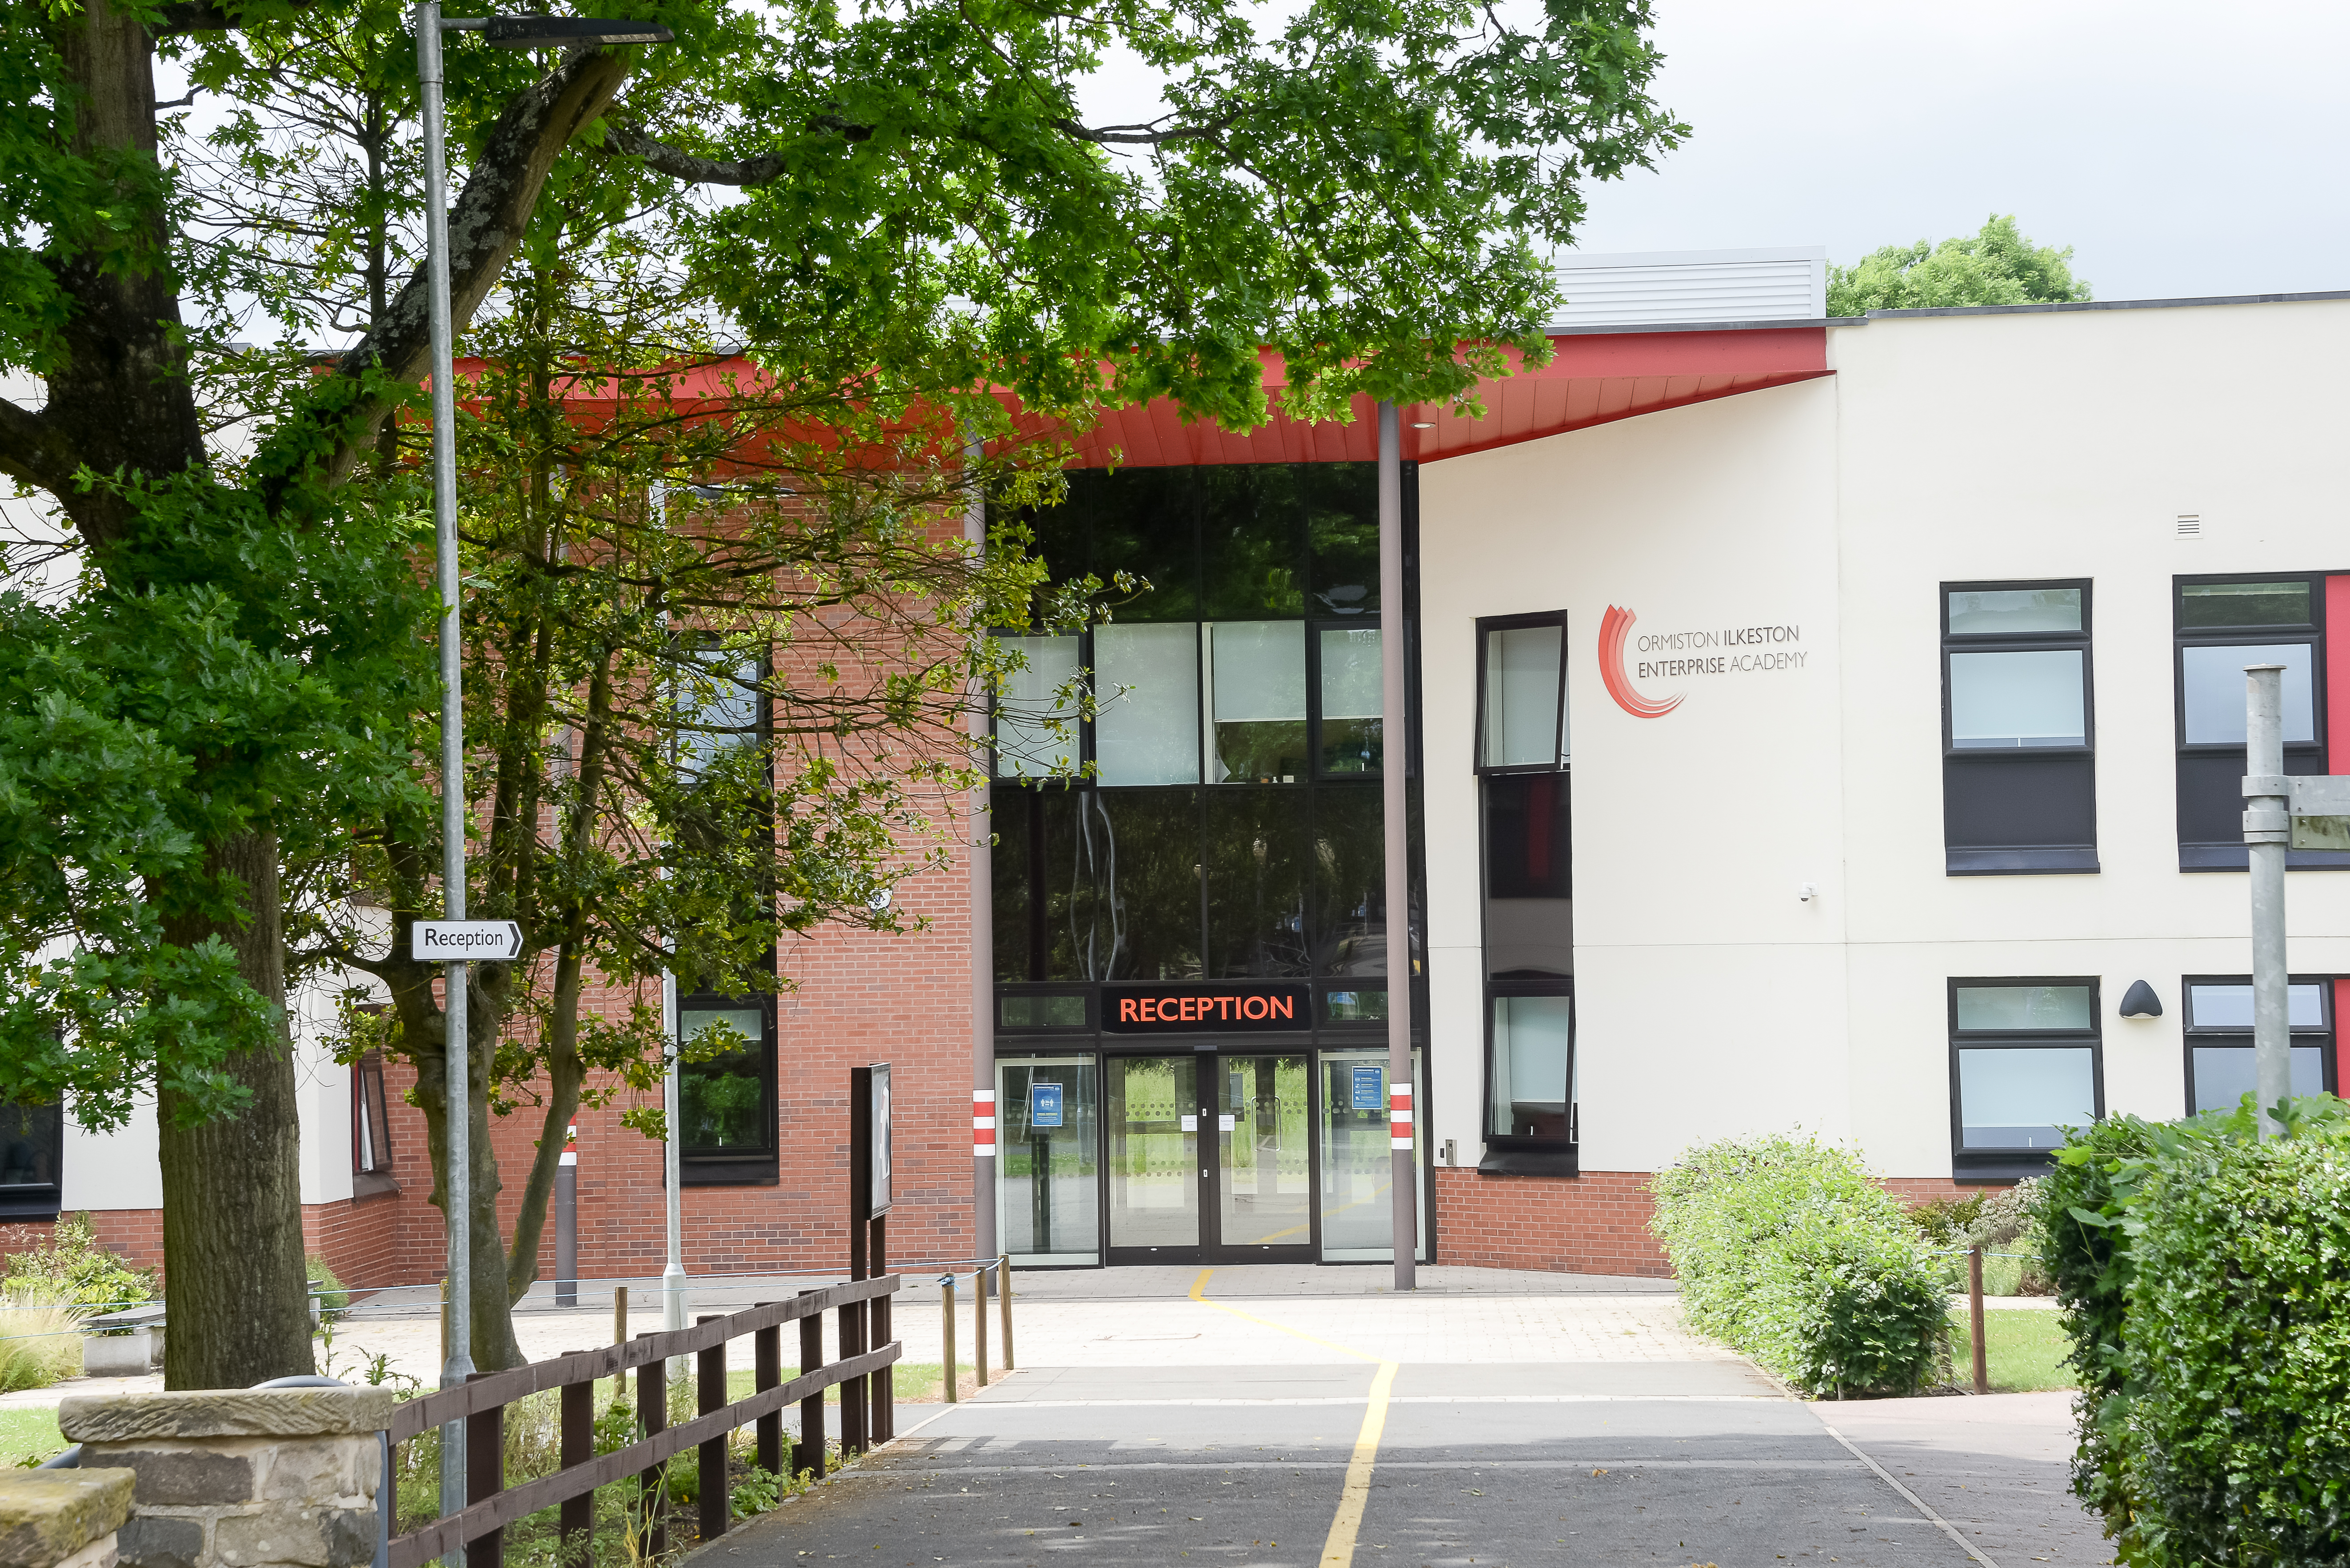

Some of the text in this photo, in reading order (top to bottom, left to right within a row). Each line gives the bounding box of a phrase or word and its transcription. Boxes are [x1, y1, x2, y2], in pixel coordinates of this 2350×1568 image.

[1637, 625, 1799, 652] ORMISTON ILKESTON
[1639, 651, 1808, 678] ENTERPRISE ACADEMY
[425, 928, 503, 951] Reception
[1120, 996, 1293, 1022] RECEPTION
